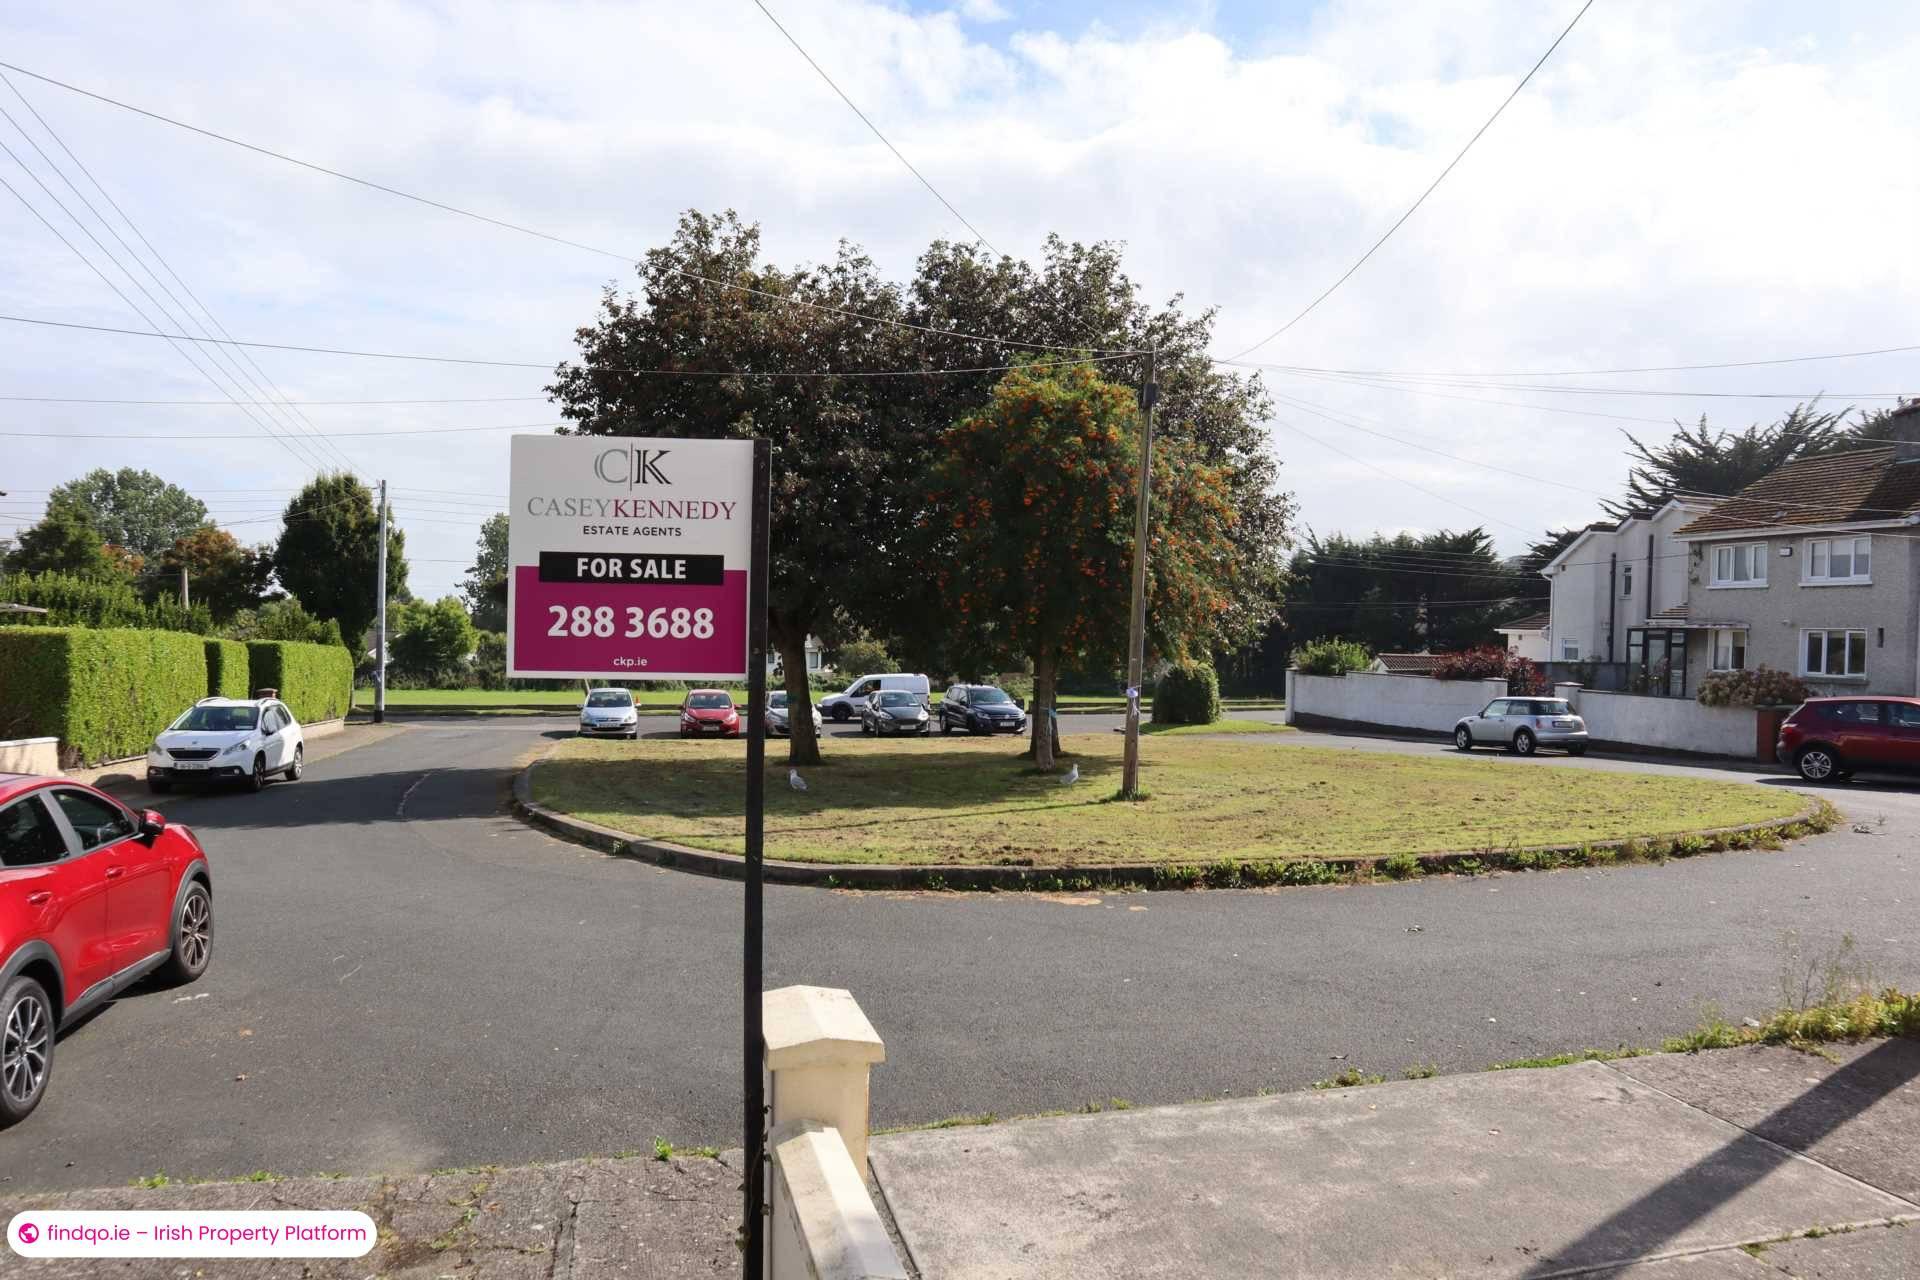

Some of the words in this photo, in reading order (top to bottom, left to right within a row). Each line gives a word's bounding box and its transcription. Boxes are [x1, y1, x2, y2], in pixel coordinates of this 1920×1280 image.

[583, 525, 629, 536] ESTATE
[633, 526, 682, 537] AGENTS
[576, 557, 623, 578] FOR
[630, 558, 687, 579] SALE
[547, 605, 615, 638] 288
[624, 606, 715, 639] 3688
[613, 656, 648, 668] ckp.ie
